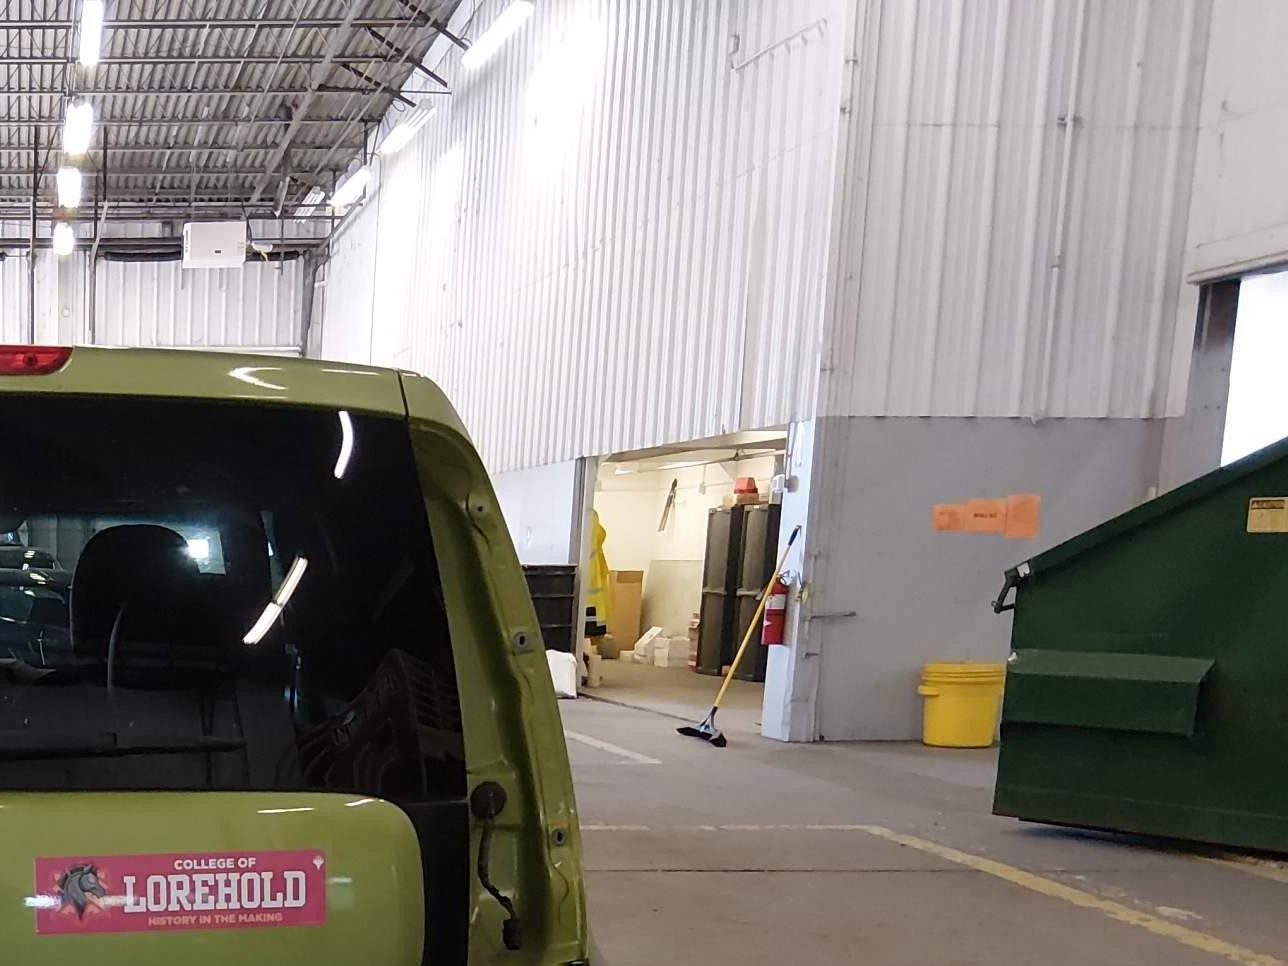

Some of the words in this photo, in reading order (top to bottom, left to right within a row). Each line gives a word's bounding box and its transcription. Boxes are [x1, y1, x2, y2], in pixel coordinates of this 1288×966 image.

[174, 857, 234, 871] COLLEGE
[238, 857, 257, 868] OF
[123, 870, 306, 913] LOREHOLD
[148, 915, 197, 927] HISTORY
[199, 914, 212, 925] IN
[214, 913, 236, 924] THE
[238, 912, 283, 923] MAKING
